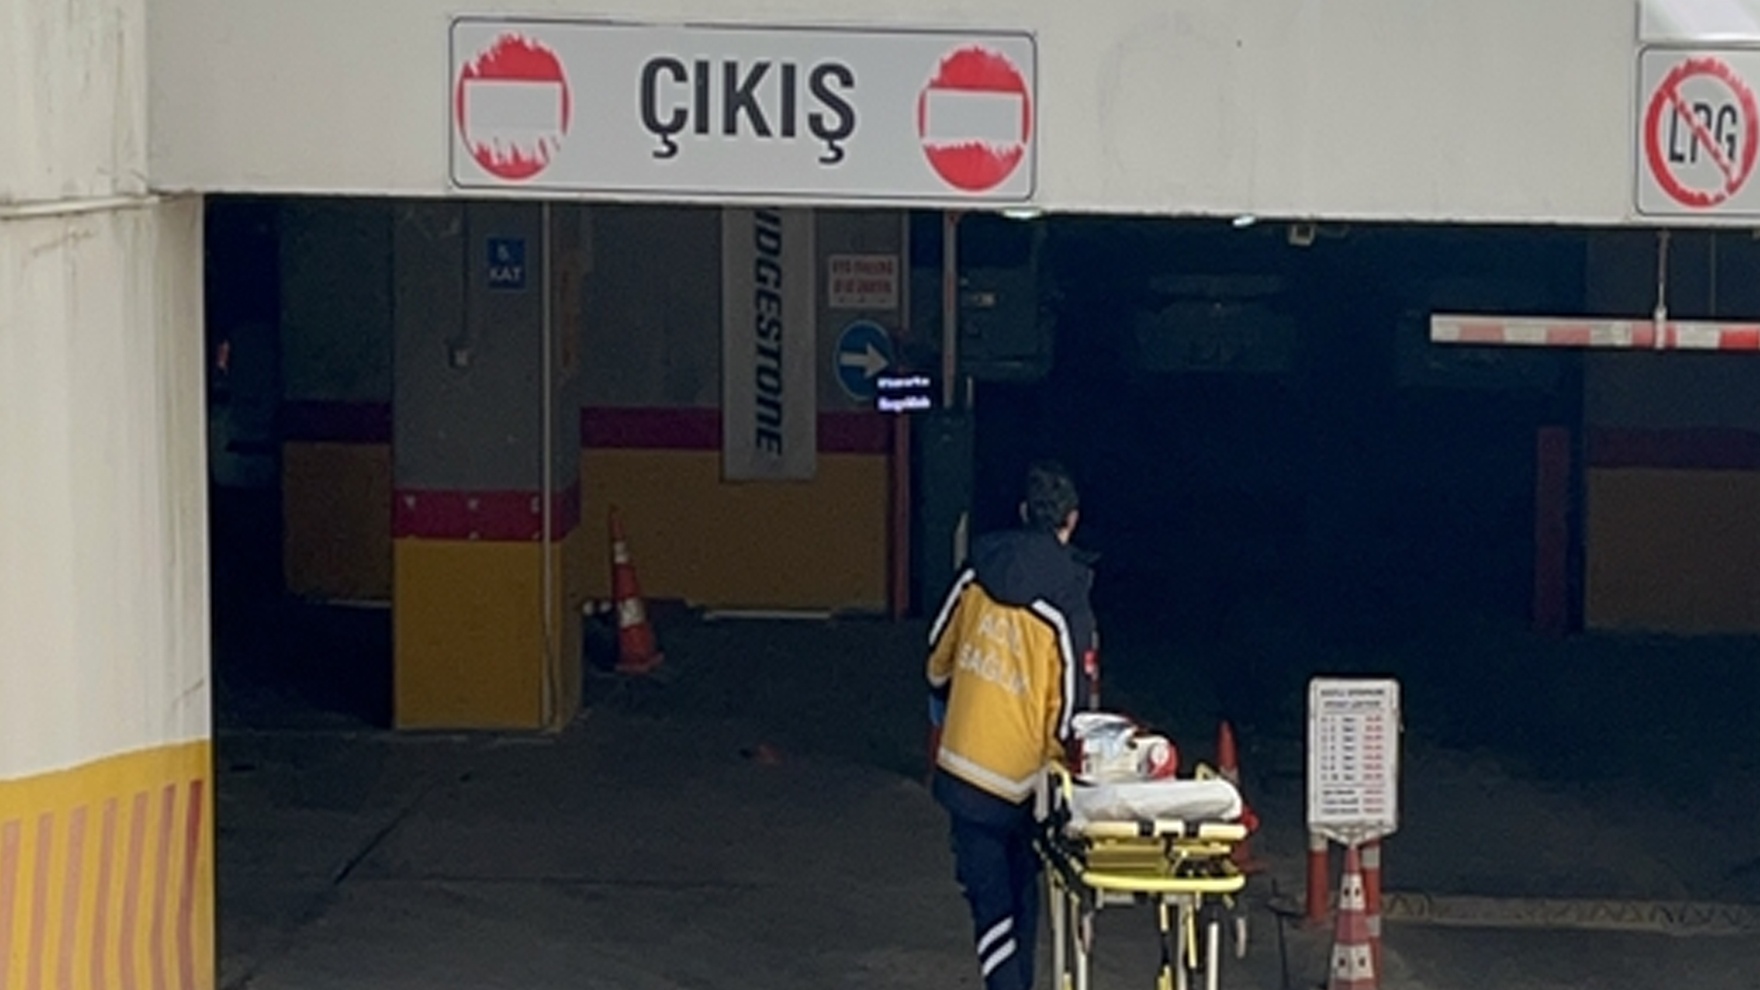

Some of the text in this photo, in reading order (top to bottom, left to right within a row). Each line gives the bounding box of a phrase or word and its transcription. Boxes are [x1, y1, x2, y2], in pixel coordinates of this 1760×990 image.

[639, 57, 855, 164] ÇIKIŞ
[1668, 102, 1737, 163] LPG
[755, 205, 783, 456] IDGESTONE
